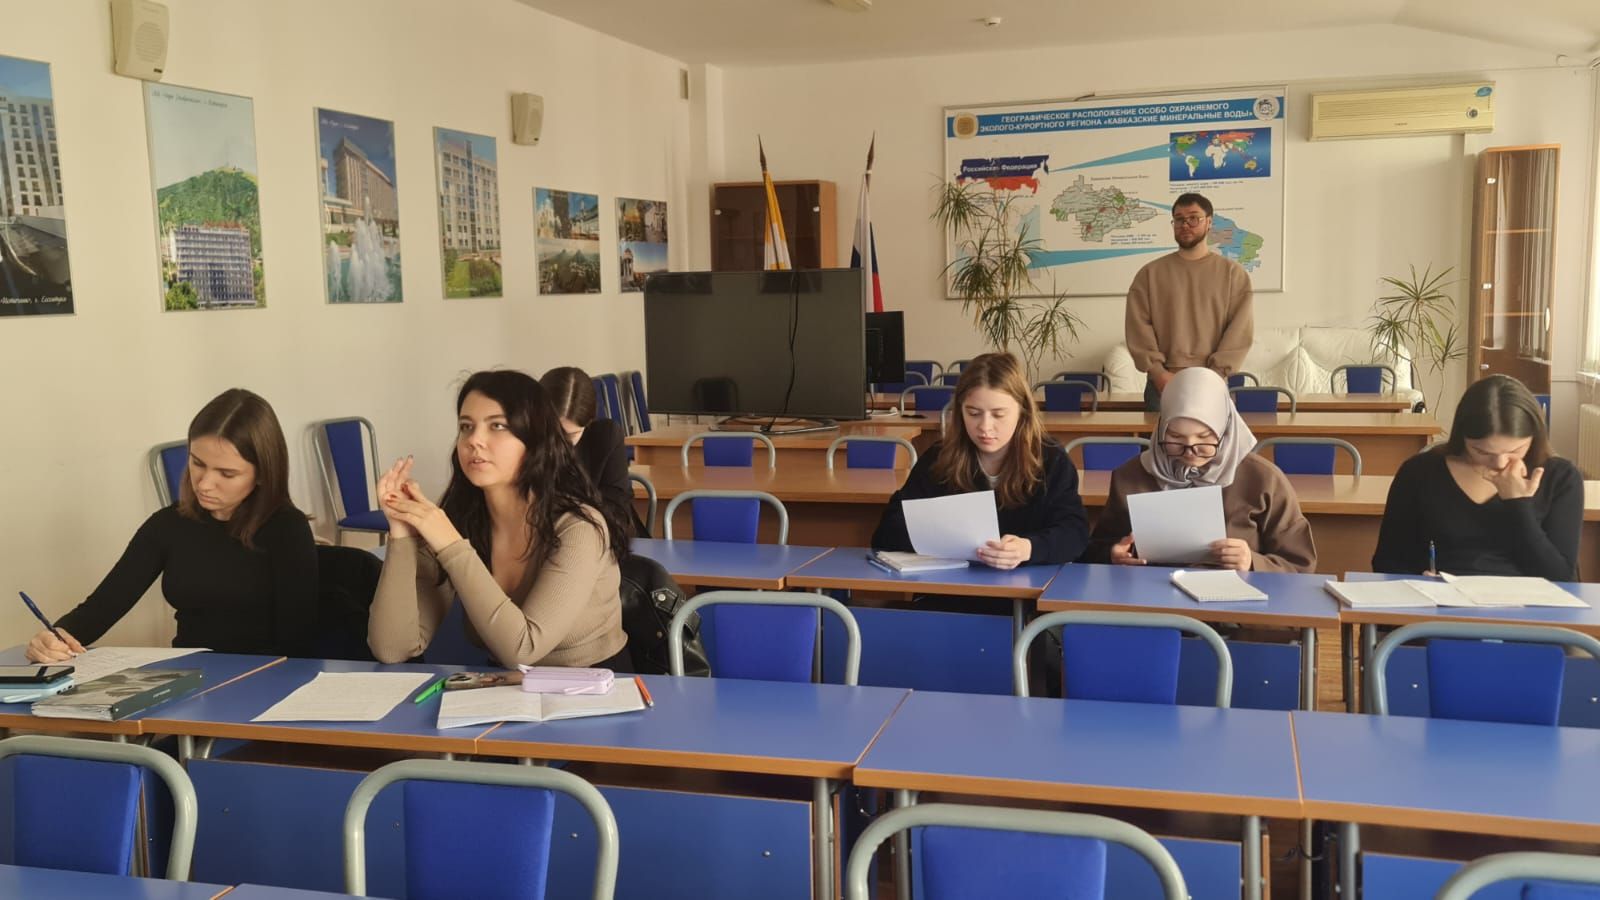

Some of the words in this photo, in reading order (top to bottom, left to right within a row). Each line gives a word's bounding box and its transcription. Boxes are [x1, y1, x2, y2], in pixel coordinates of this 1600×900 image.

[980, 121, 1065, 132] ЭКОЛОГО-КУРОРТНОГО
[1066, 119, 1102, 127] РЕГИОНА
[1103, 115, 1158, 125] «КАВКАЗСКИЕ
[1159, 112, 1222, 122] МИНЕРАЛЬНЫЕ
[1223, 110, 1253, 119] ВОДЫ»
[1001, 112, 1071, 123] ГЕОГРАФИЧЕСКОЕ
[1072, 108, 1137, 119] РАСПОЛОЖЕНИЕ
[1138, 107, 1167, 115] ОСОБО
[1169, 103, 1230, 113] ОХРАНЯЕМОГО
